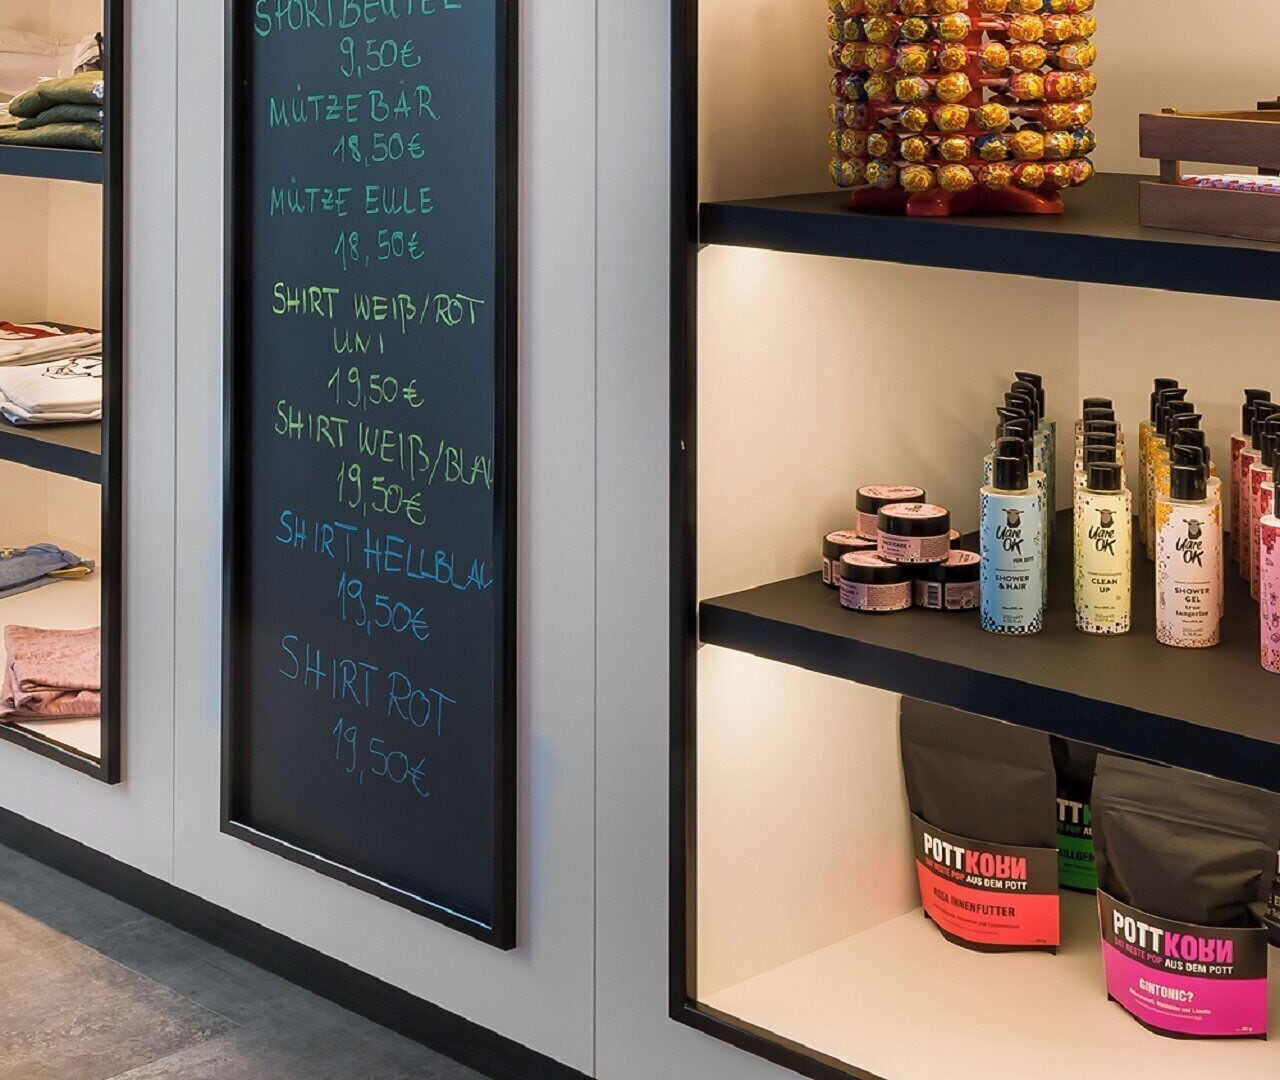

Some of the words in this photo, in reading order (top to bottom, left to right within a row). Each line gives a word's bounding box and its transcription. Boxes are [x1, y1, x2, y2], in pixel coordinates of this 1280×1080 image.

[338, 35, 422, 79] 9,50€
[331, 132, 426, 168] 18,50€
[269, 175, 352, 217] MÜTZE
[365, 184, 435, 215] EULE
[333, 228, 426, 271] 18,50€
[272, 281, 340, 319] SHIRT
[332, 326, 385, 355] UNI
[327, 366, 425, 411] 19,50€
[274, 399, 350, 449] SHIRT
[336, 461, 427, 526] 19,50€
[275, 509, 358, 563] SHIRT
[1002, 538, 1025, 556] OK
[1095, 538, 1117, 557] OK
[1182, 549, 1205, 568] OK
[994, 574, 1030, 582] SHOWER
[1005, 582, 1027, 590] HAIR
[1174, 587, 1210, 595] SHOWER
[336, 571, 431, 642] 19,50€
[1184, 595, 1202, 603] GEL
[278, 633, 379, 708] SHIRT
[386, 670, 457, 736] ROT
[331, 717, 430, 798] 19,50€
[923, 831, 1028, 880] POTTKORN
[933, 886, 951, 904] ROSA
[950, 893, 1016, 917] INNENFUTTER
[965, 875, 983, 886] AUS
[983, 878, 1003, 889] DEM
[1005, 881, 1028, 891] POTT
[1113, 908, 1234, 964] POTTKORN
[1146, 952, 1163, 964] POP
[1164, 958, 1184, 971] AUS
[1184, 961, 1207, 975] DEM
[1209, 965, 1234, 975] POTT
[1138, 977, 1195, 1003] GINTONIC?
